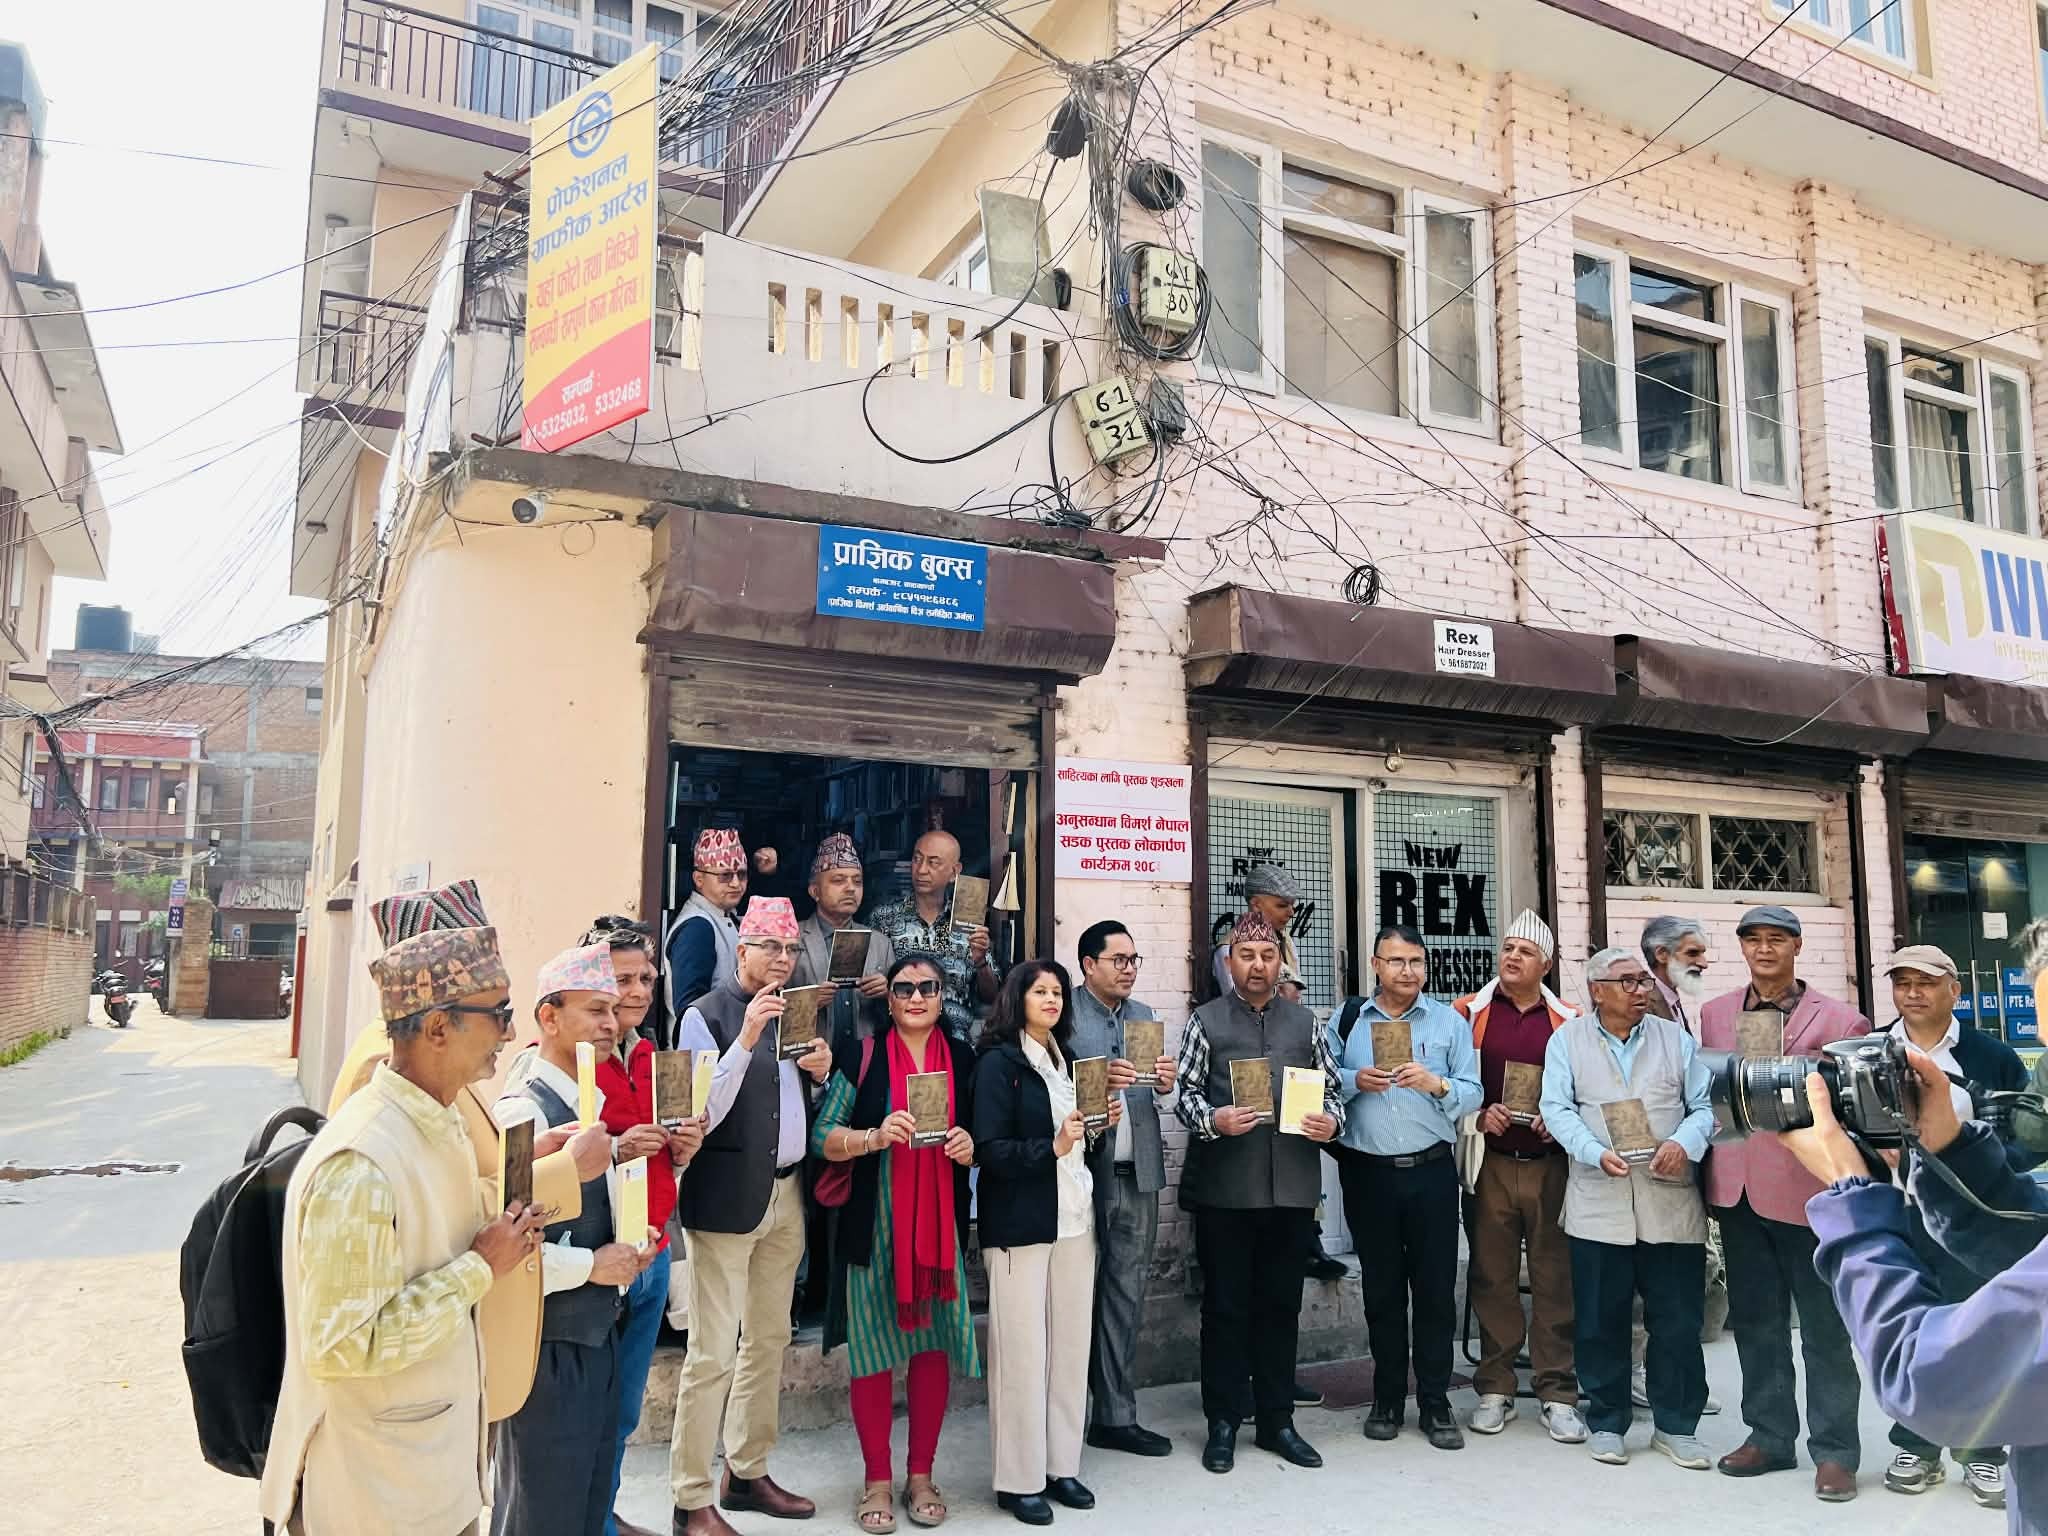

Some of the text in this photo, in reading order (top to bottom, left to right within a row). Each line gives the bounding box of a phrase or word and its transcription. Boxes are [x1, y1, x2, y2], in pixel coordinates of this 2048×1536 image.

[547, 153, 629, 221] प्रोफेशनल
[595, 377, 642, 416] 5332468
[1095, 385, 1128, 412] 61
[1105, 420, 1143, 441] 31
[920, 552, 974, 581] बुक्स
[1446, 627, 1479, 645] Rex
[1438, 645, 1490, 658] Hair Dresser
[1057, 767, 1098, 783] साहित्यका
[1100, 771, 1121, 784] लागि
[1056, 813, 1189, 832] अनुसन्धान विमर्श नेपाल
[1060, 835, 1186, 853] सडक पुस्तक लोकार्पण
[1247, 847, 1274, 857] NEW
[1404, 839, 1462, 869] NEW
[1080, 856, 1131, 872] कार्यक्रम
[1380, 870, 1491, 937] REX
[2008, 995, 2024, 1008] PTE
